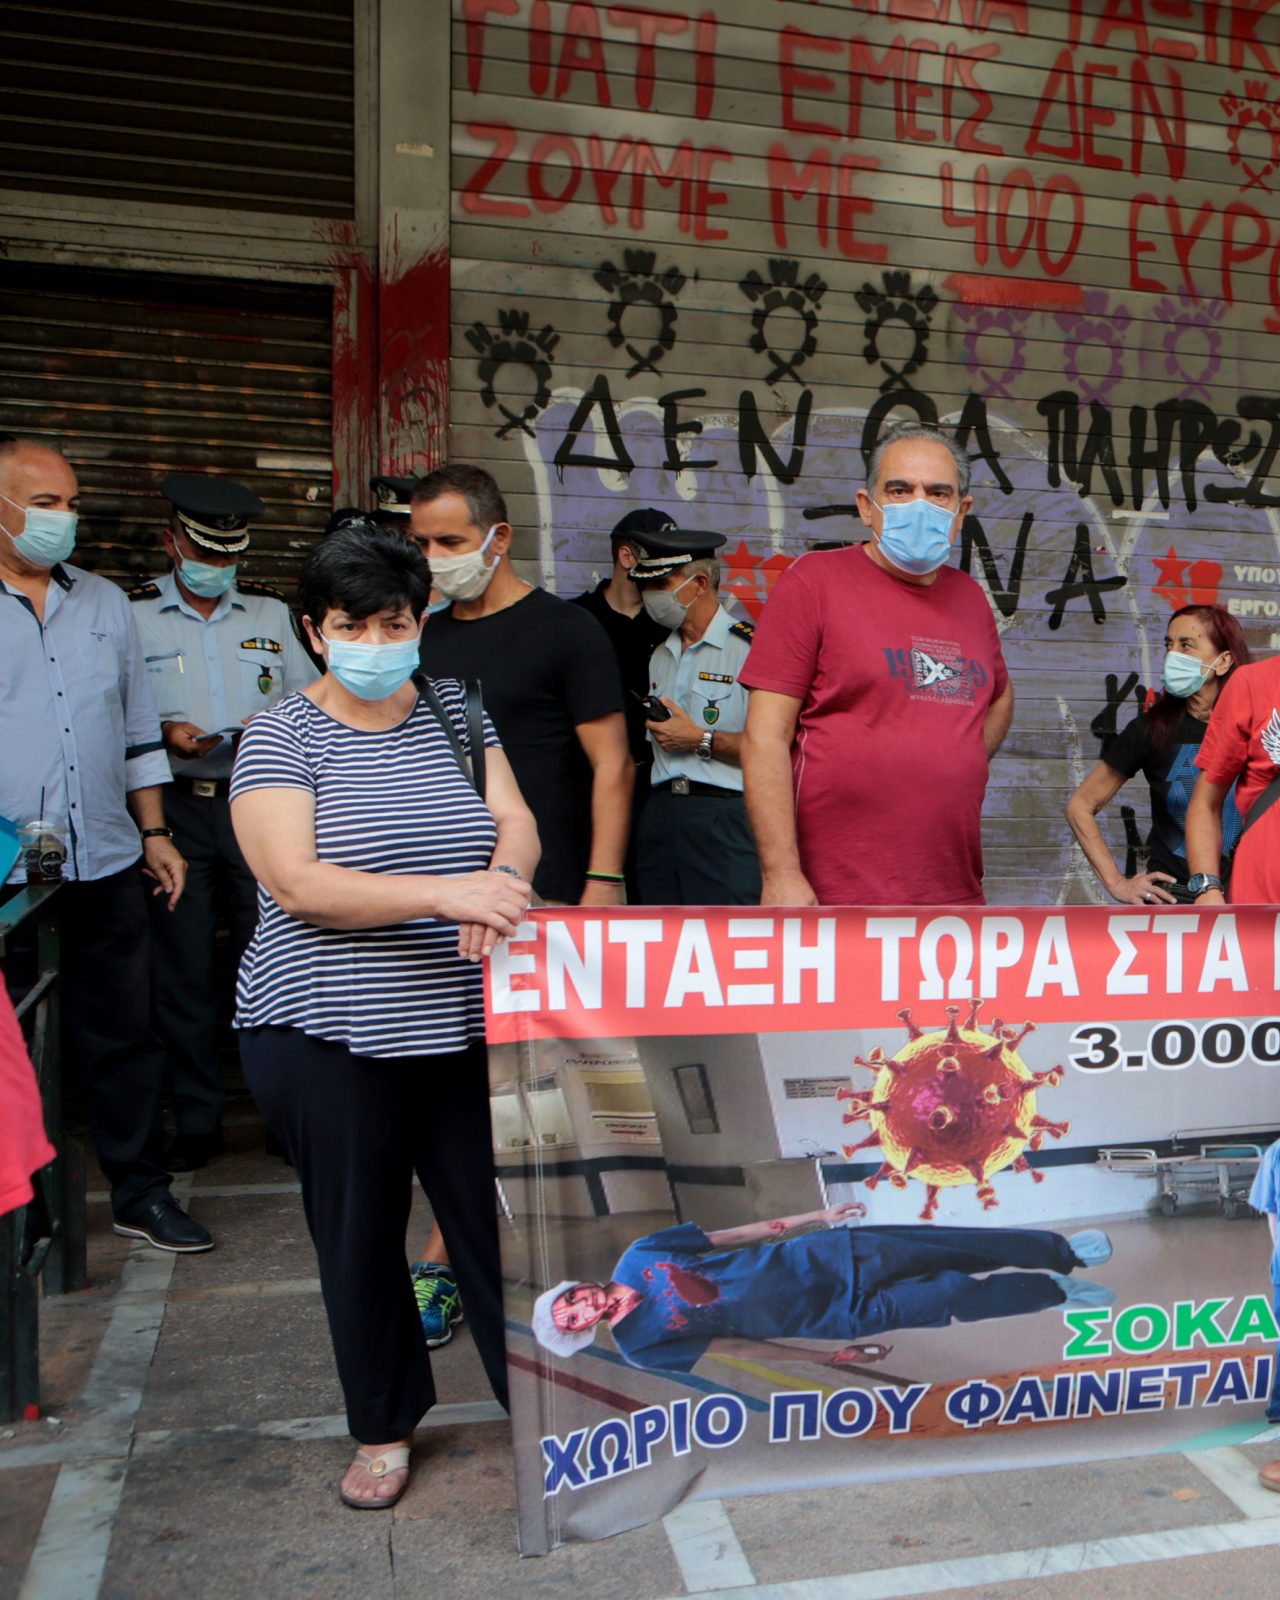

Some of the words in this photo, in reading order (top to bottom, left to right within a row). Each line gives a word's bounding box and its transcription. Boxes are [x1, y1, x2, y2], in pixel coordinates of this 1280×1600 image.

[940, 161, 1085, 276] 400
[552, 373, 813, 485] ΔΕΝ
[865, 915, 1081, 1003] ΤΩΡΑ
[1105, 913, 1249, 996] ΣΤΑ
[540, 1393, 747, 1499] ΧΩΡΙΟ
[769, 1383, 931, 1443] ΠΟΥ
[944, 1355, 1275, 1428] ΦΑΙΝΕΤΑΙ
